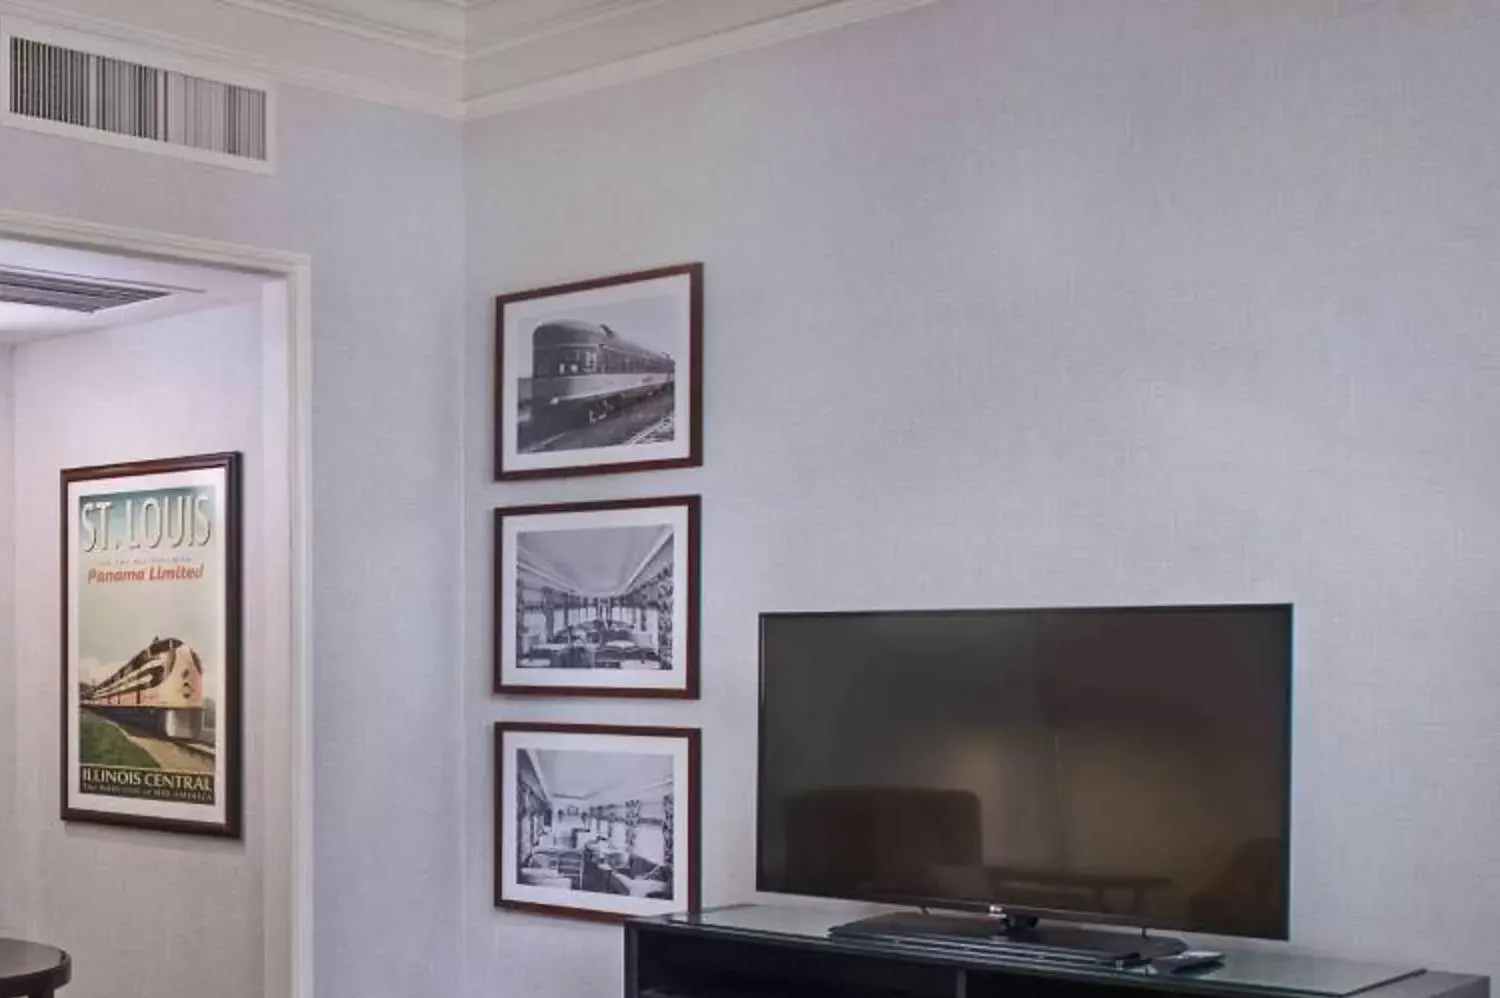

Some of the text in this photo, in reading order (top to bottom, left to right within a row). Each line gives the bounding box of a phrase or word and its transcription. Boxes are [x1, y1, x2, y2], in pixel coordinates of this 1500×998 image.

[82, 496, 211, 552] ST. LOUIS
[88, 563, 205, 584] Panama Limited
[83, 768, 142, 785] ILLINOIS
[144, 773, 213, 791] CENTRAL
